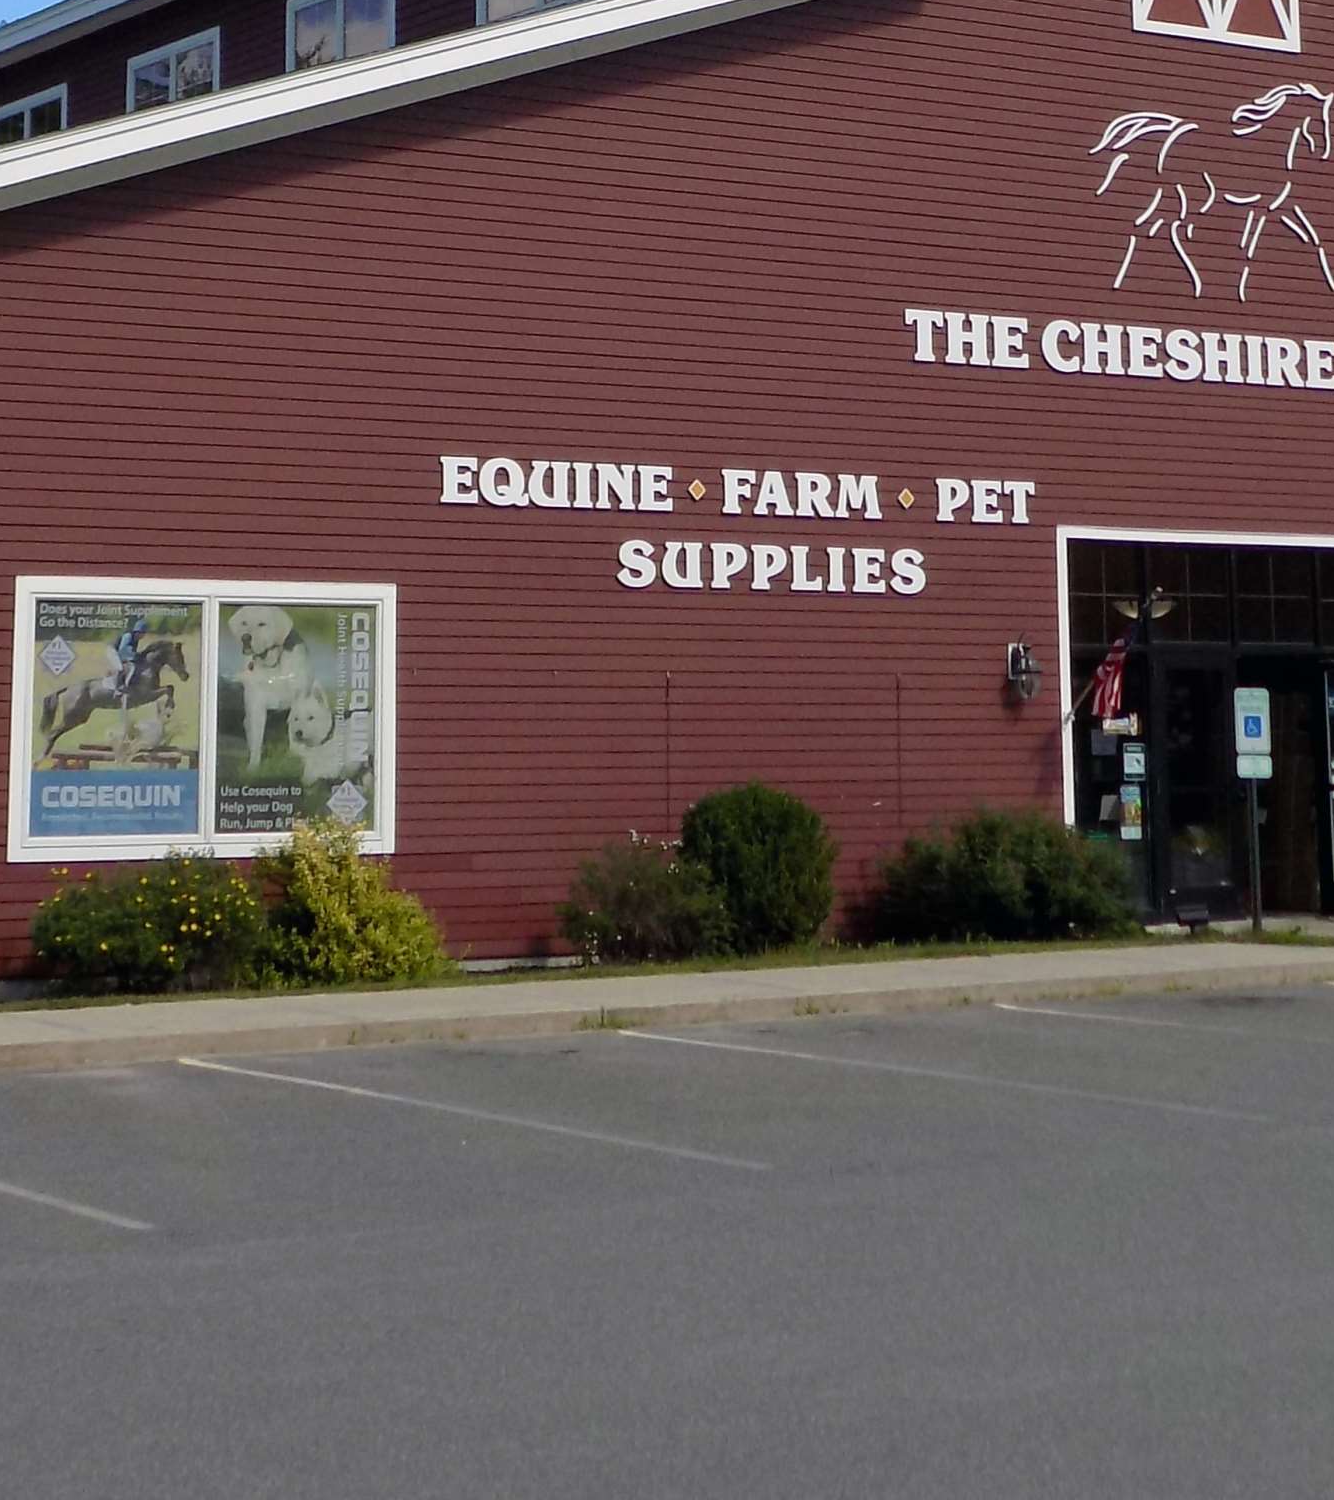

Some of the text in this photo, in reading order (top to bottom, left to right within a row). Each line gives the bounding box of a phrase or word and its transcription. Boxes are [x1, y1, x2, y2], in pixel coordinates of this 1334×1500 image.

[905, 308, 1030, 370] THE
[439, 455, 1037, 527] EQUINE FARM PET
[616, 539, 928, 596] SUPPLIES
[39, 603, 68, 615] Does
[69, 605, 94, 617] your
[95, 604, 122, 616] Joint
[39, 616, 128, 628] Go the Distance?
[337, 612, 348, 644] Joint
[350, 611, 370, 763] COSEQUIN
[42, 785, 180, 810] COSEQUIN
[220, 786, 302, 799] Use Cosequin to
[220, 802, 294, 815] Help your Dog
[220, 818, 243, 830] Run,
[245, 818, 273, 830] Jump
[275, 818, 284, 829] &
